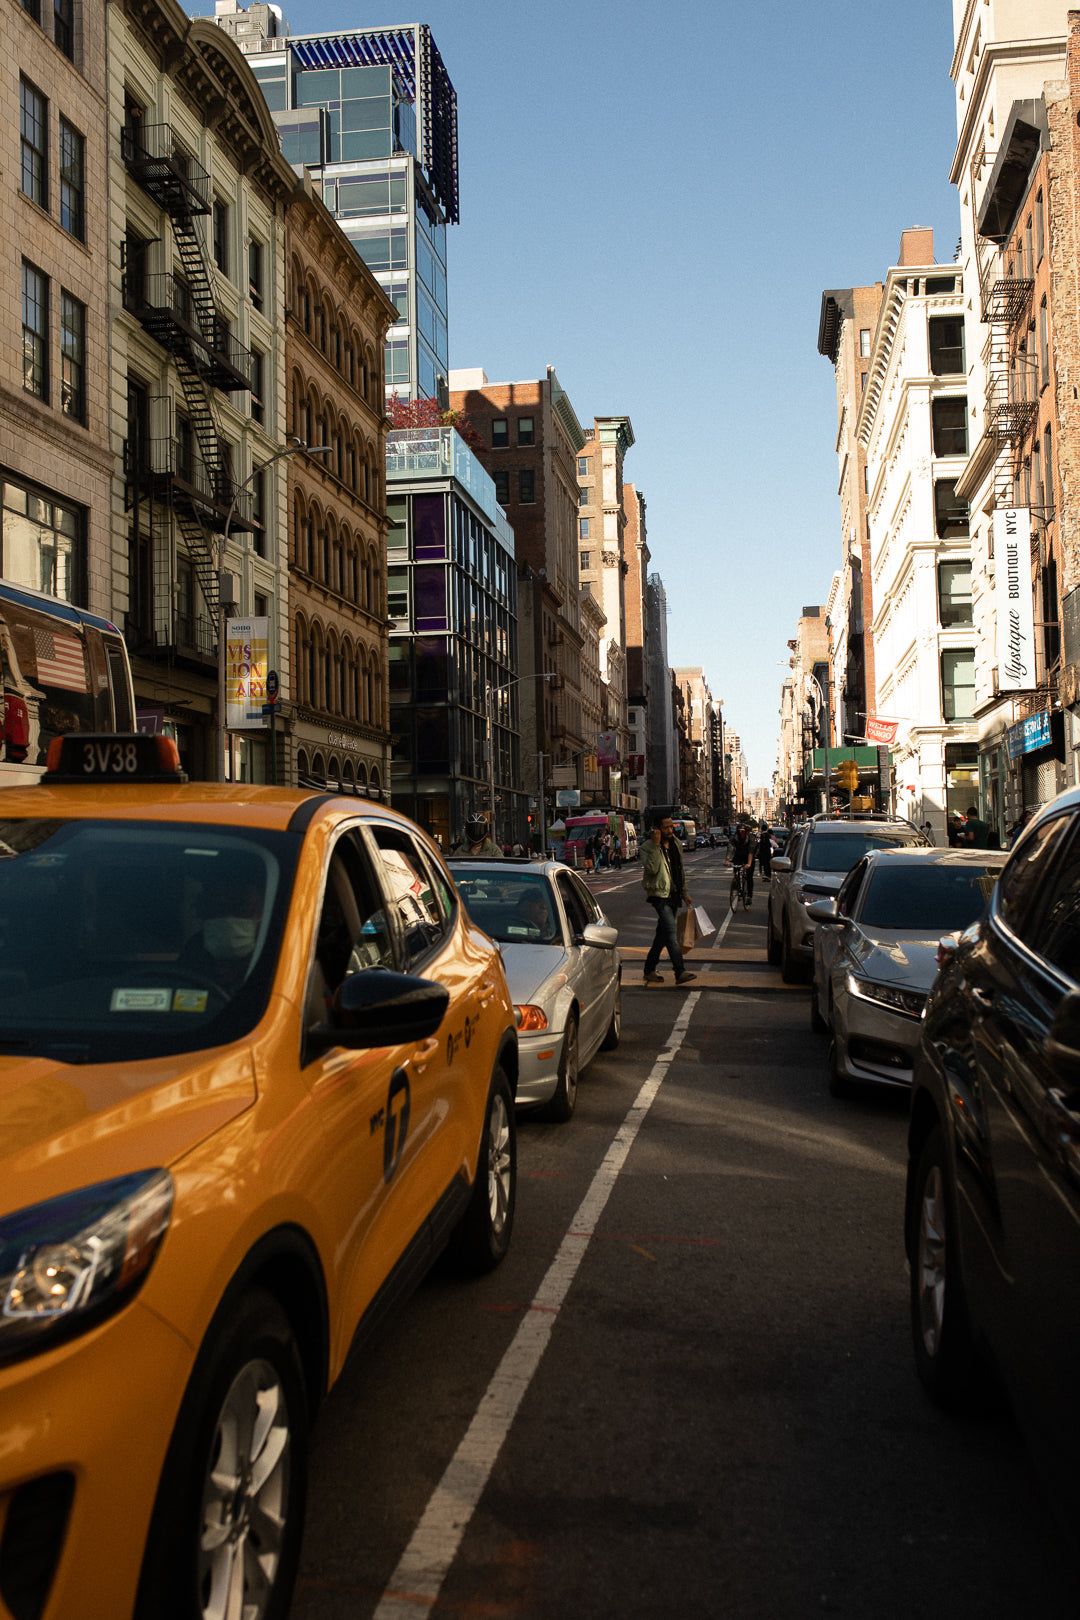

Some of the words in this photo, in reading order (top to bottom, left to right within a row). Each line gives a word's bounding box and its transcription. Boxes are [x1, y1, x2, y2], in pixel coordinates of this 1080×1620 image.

[1005, 511, 1017, 535] NYC
[1006, 543, 1020, 599] BOUTIQUE
[228, 644, 252, 661] VIS
[1004, 608, 1027, 687] Mystique
[232, 662, 263, 679] ION
[235, 681, 267, 698] ARY
[868, 720, 893, 731] WELLS
[868, 728, 892, 739] FARGO
[83, 743, 138, 773] 3V38
